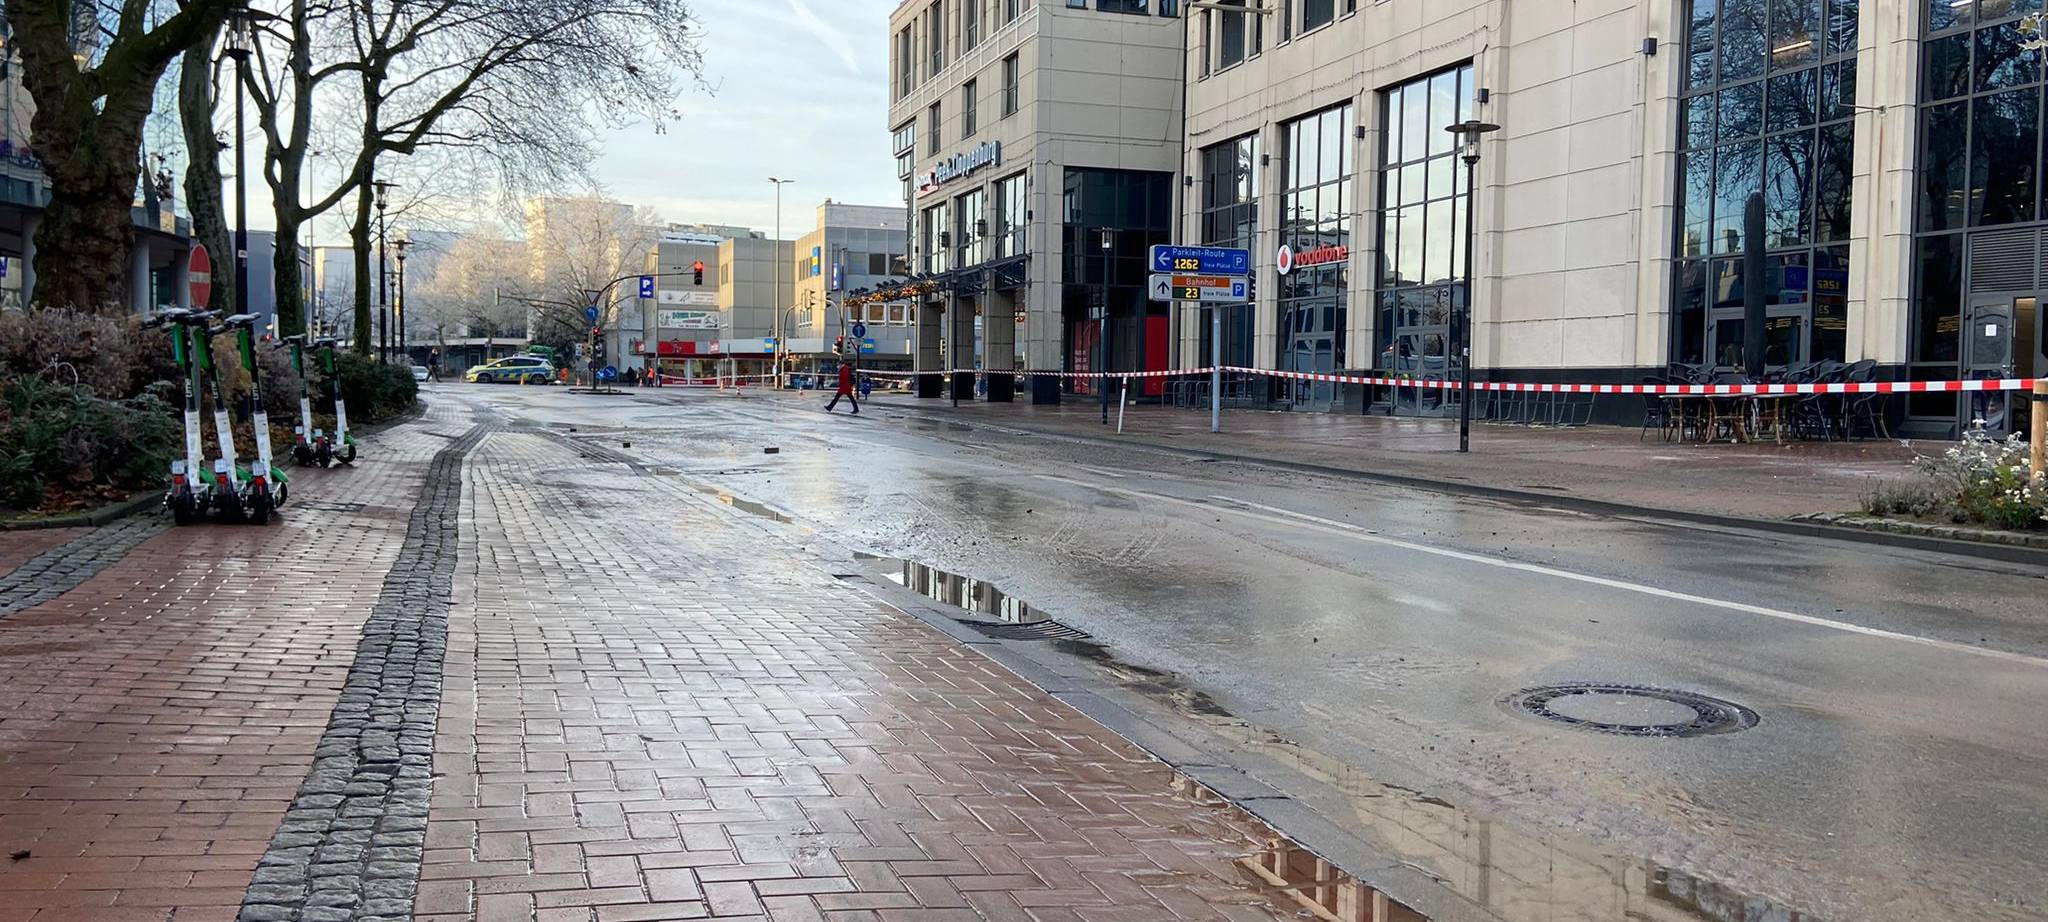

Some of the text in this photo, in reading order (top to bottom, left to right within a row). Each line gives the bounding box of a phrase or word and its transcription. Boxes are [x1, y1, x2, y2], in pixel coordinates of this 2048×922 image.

[1172, 248, 1226, 258] Parkleit-Route
[1295, 245, 1347, 265] vodafone
[1174, 258, 1199, 269] 1262
[1235, 257, 1243, 266] P
[642, 280, 651, 288] P
[1186, 278, 1217, 286] Bahnhof
[1185, 288, 1198, 298] 23
[1235, 285, 1242, 295] P
